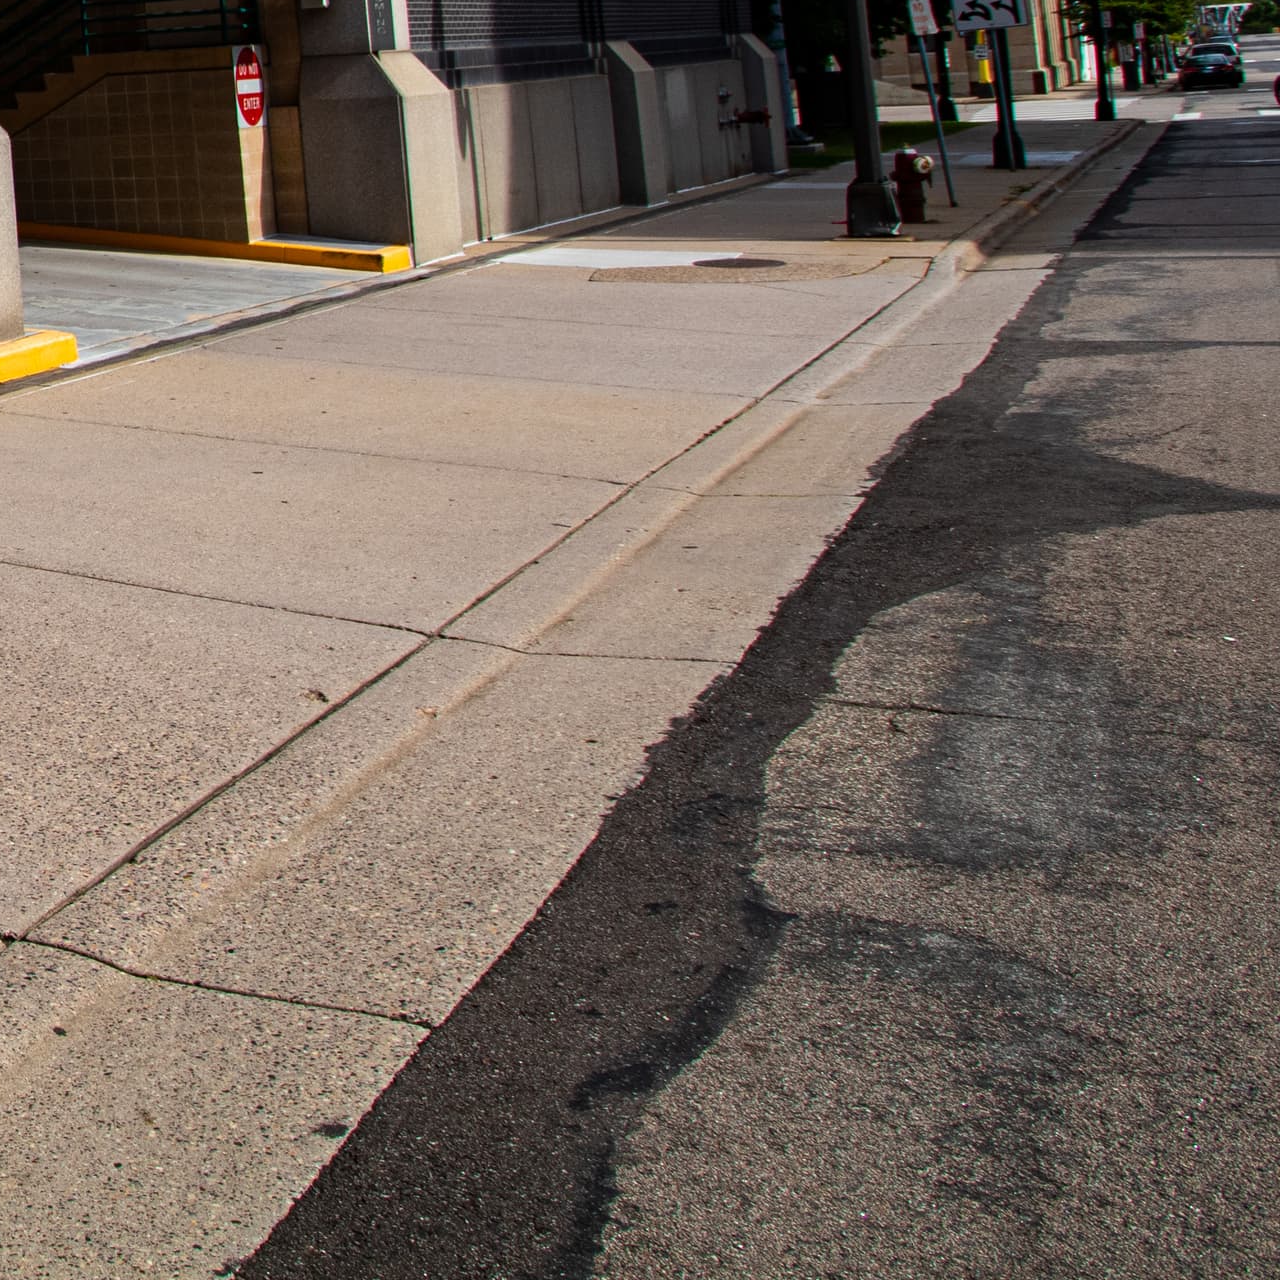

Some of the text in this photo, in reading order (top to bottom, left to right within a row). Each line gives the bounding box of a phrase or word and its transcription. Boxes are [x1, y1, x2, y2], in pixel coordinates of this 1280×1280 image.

[238, 62, 259, 76] DO NOT
[242, 96, 261, 111] ENTER
